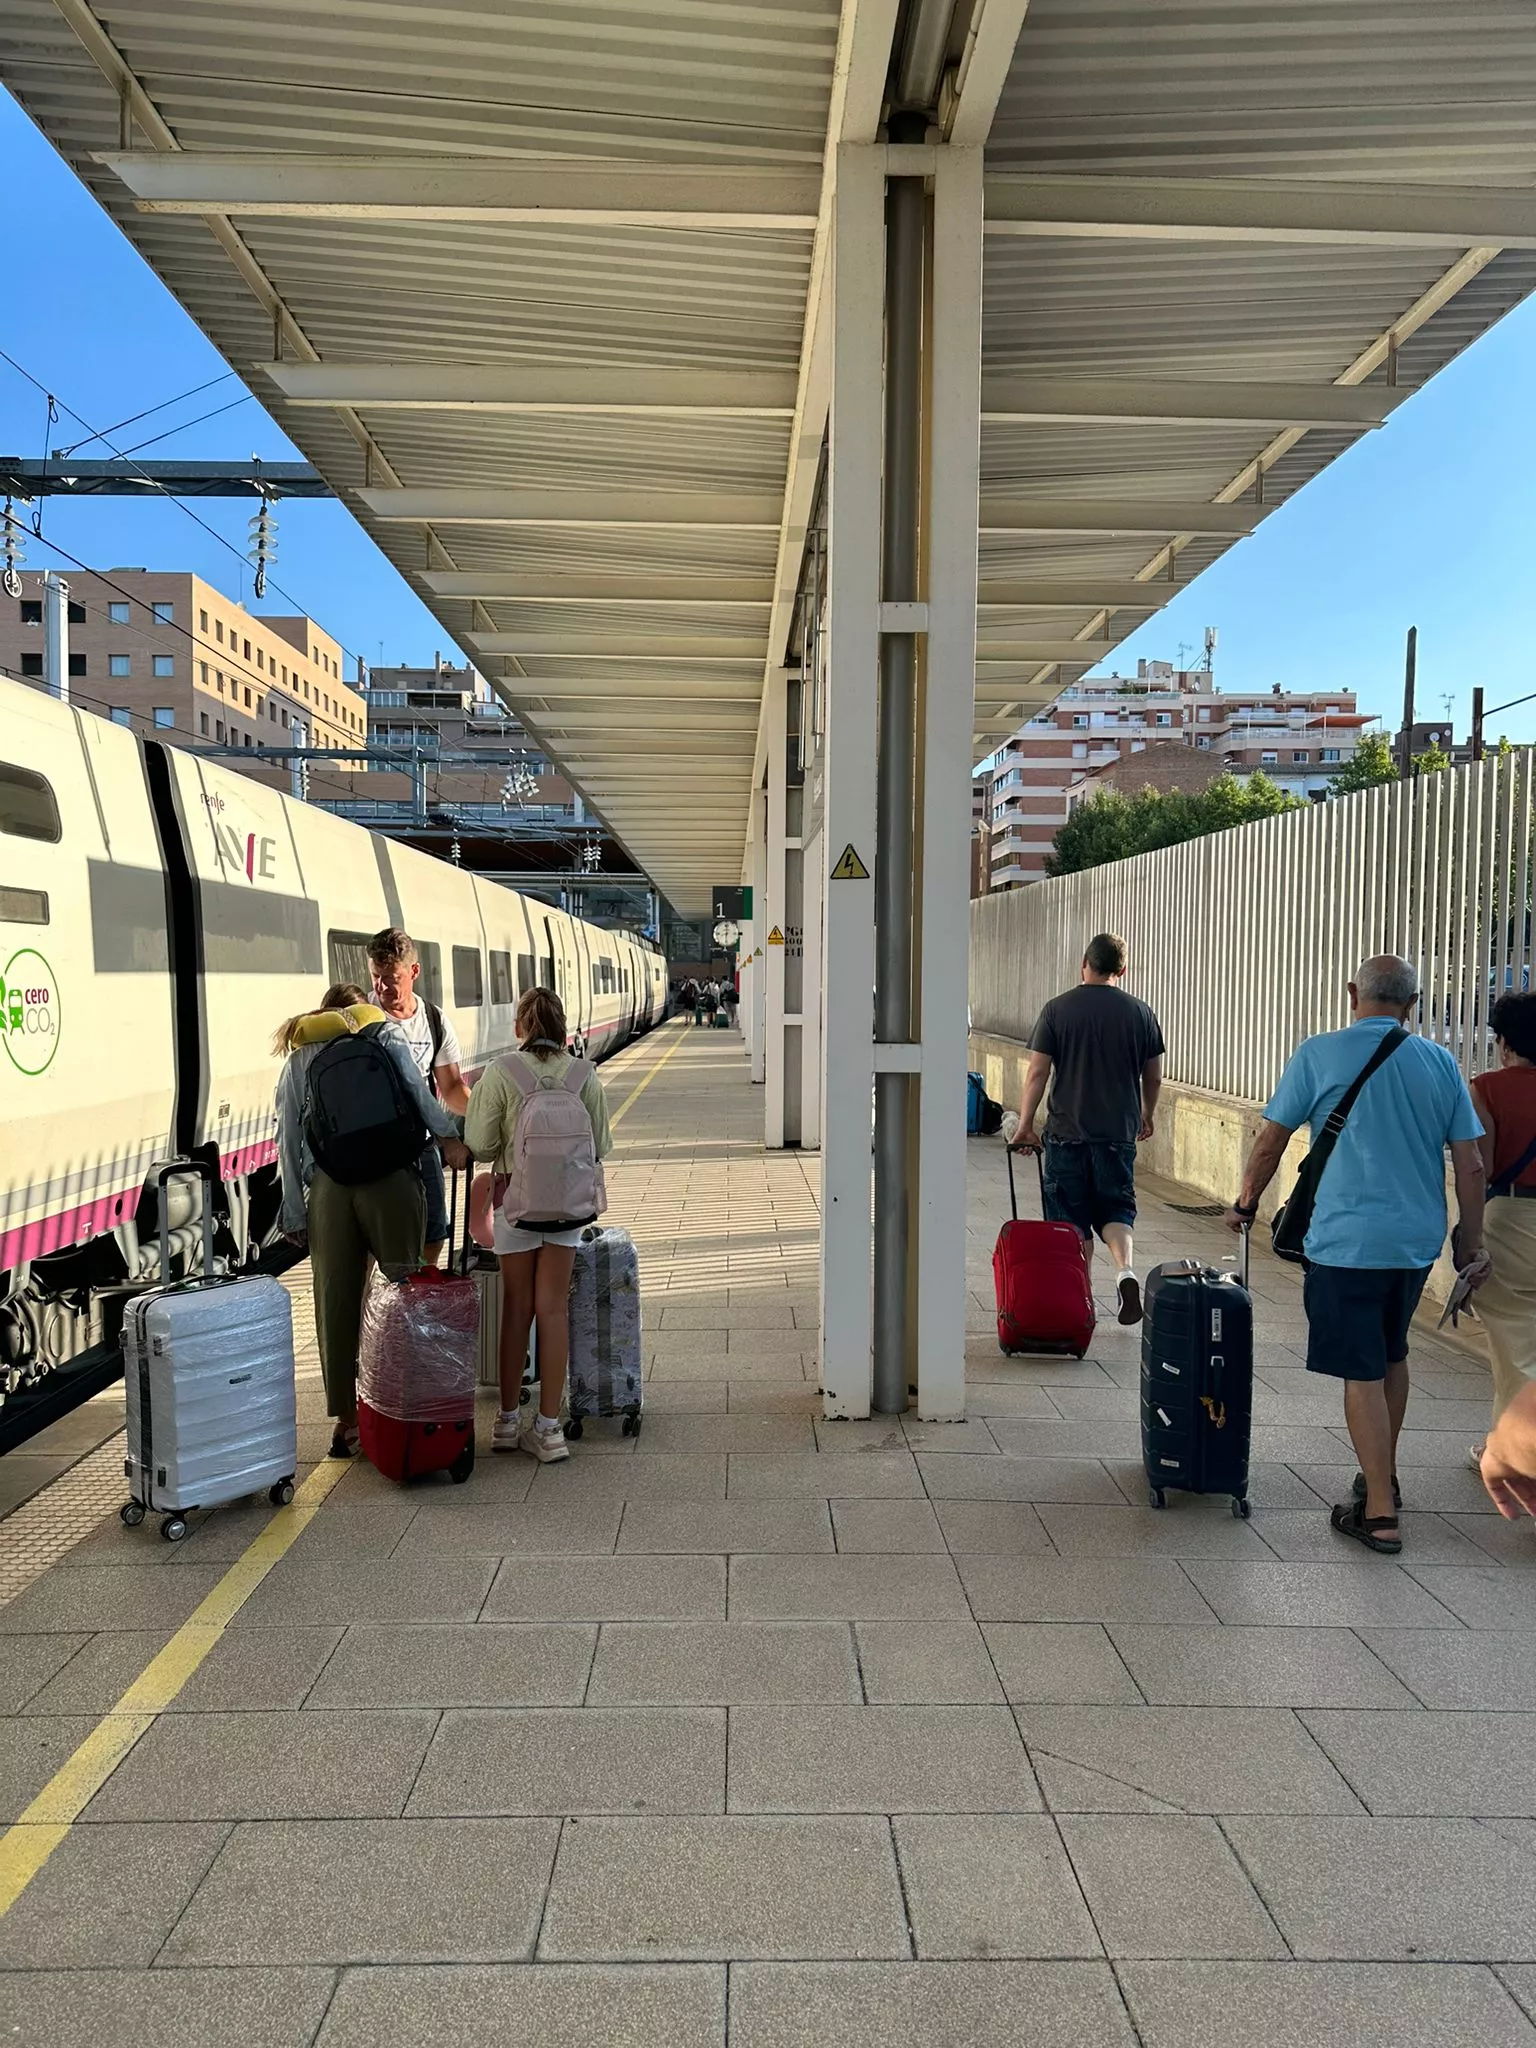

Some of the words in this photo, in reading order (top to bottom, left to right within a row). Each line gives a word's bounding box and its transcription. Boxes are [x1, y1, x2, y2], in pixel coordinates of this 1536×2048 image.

[200, 791, 225, 815] renfe
[214, 822, 276, 885] AVE
[716, 902, 726, 918] 1
[25, 988, 49, 1005] cero
